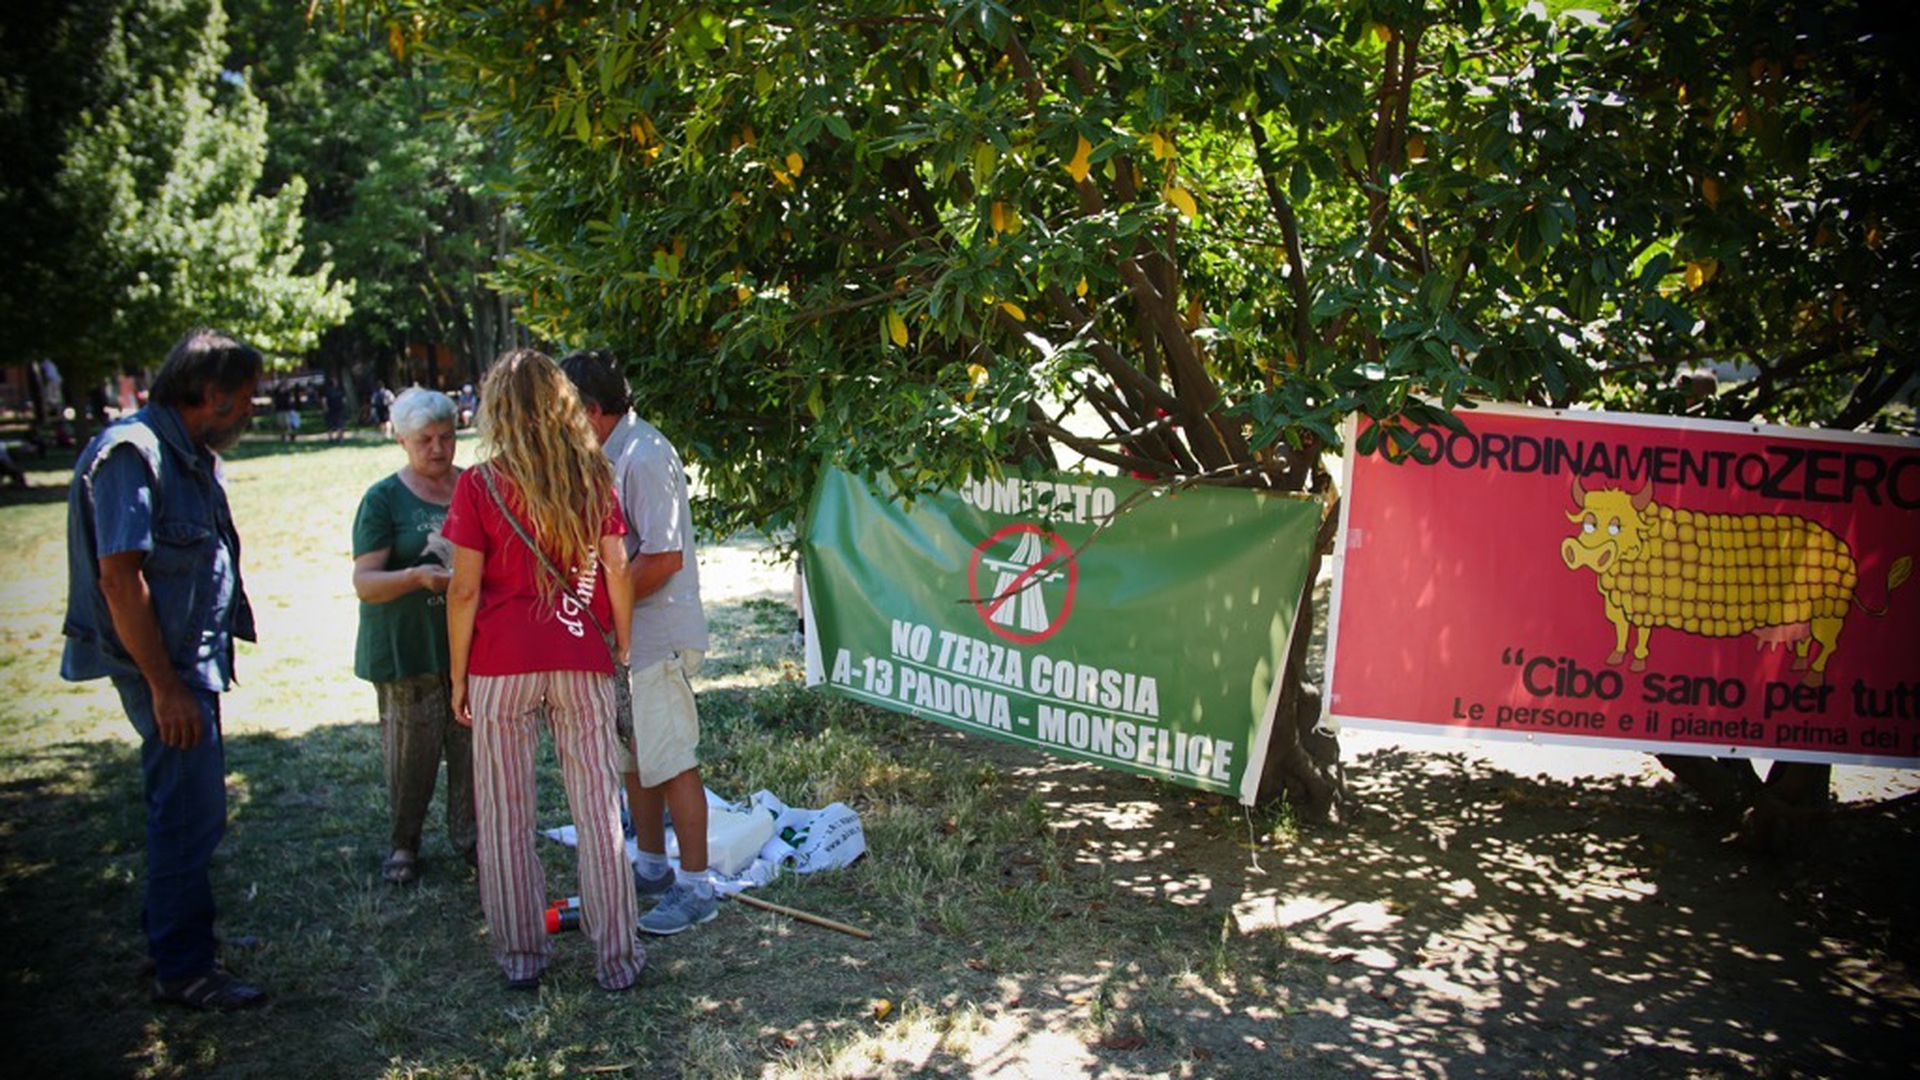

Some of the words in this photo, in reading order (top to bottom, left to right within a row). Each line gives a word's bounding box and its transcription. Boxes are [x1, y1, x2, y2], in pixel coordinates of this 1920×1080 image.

[891, 619, 930, 663] NO
[938, 632, 1022, 689] TERZA
[1030, 655, 1159, 716] CORSIA
[1642, 671, 1746, 709] sano
[1764, 680, 1834, 719] per
[831, 648, 893, 696] A-13
[900, 673, 1012, 731] PADOVA
[1038, 705, 1233, 782] MONSELICE
[1453, 697, 1484, 722] Le
[1497, 704, 1606, 731] persone
[1618, 714, 1633, 732] e
[1646, 711, 1658, 733] il
[1671, 713, 1763, 739] pianeta
[1776, 721, 1848, 746] prima
[1860, 725, 1899, 749] dei
